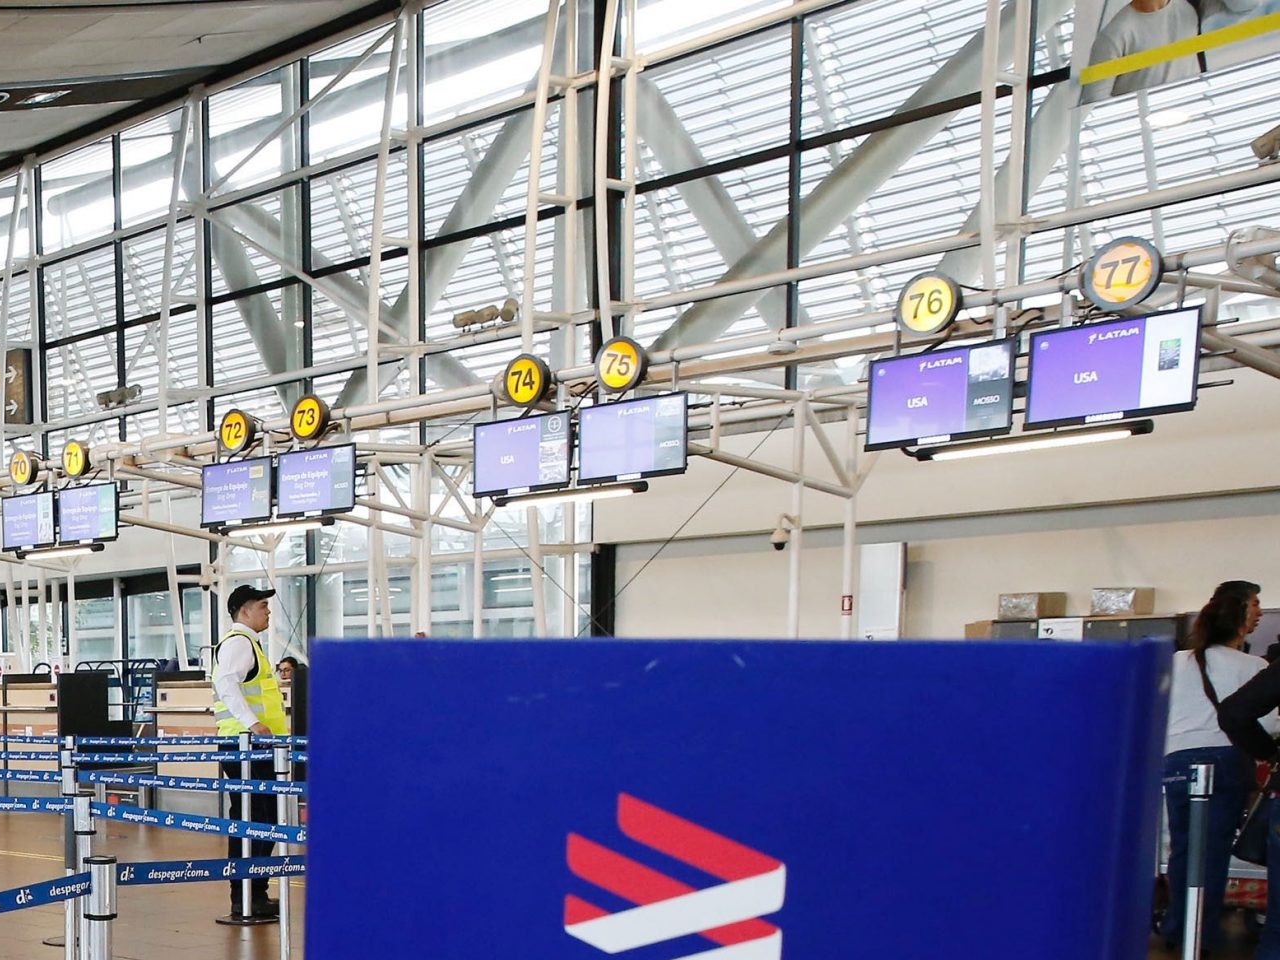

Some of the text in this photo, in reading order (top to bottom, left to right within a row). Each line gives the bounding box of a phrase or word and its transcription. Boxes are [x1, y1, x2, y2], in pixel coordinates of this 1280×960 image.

[1101, 255, 1140, 290] 77
[909, 289, 943, 320] 76
[1098, 327, 1139, 341] LATAM
[606, 351, 630, 376] 75
[927, 357, 962, 369] LATAM
[511, 368, 535, 394] 74
[1074, 371, 1098, 384] USA
[622, 406, 650, 415] LATAM
[907, 396, 928, 409] USA
[297, 408, 315, 428] 73
[225, 421, 242, 441] 72
[513, 424, 536, 433] LATAM
[66, 451, 78, 467] 71
[500, 455, 515, 464] USA
[13, 460, 26, 476] 70
